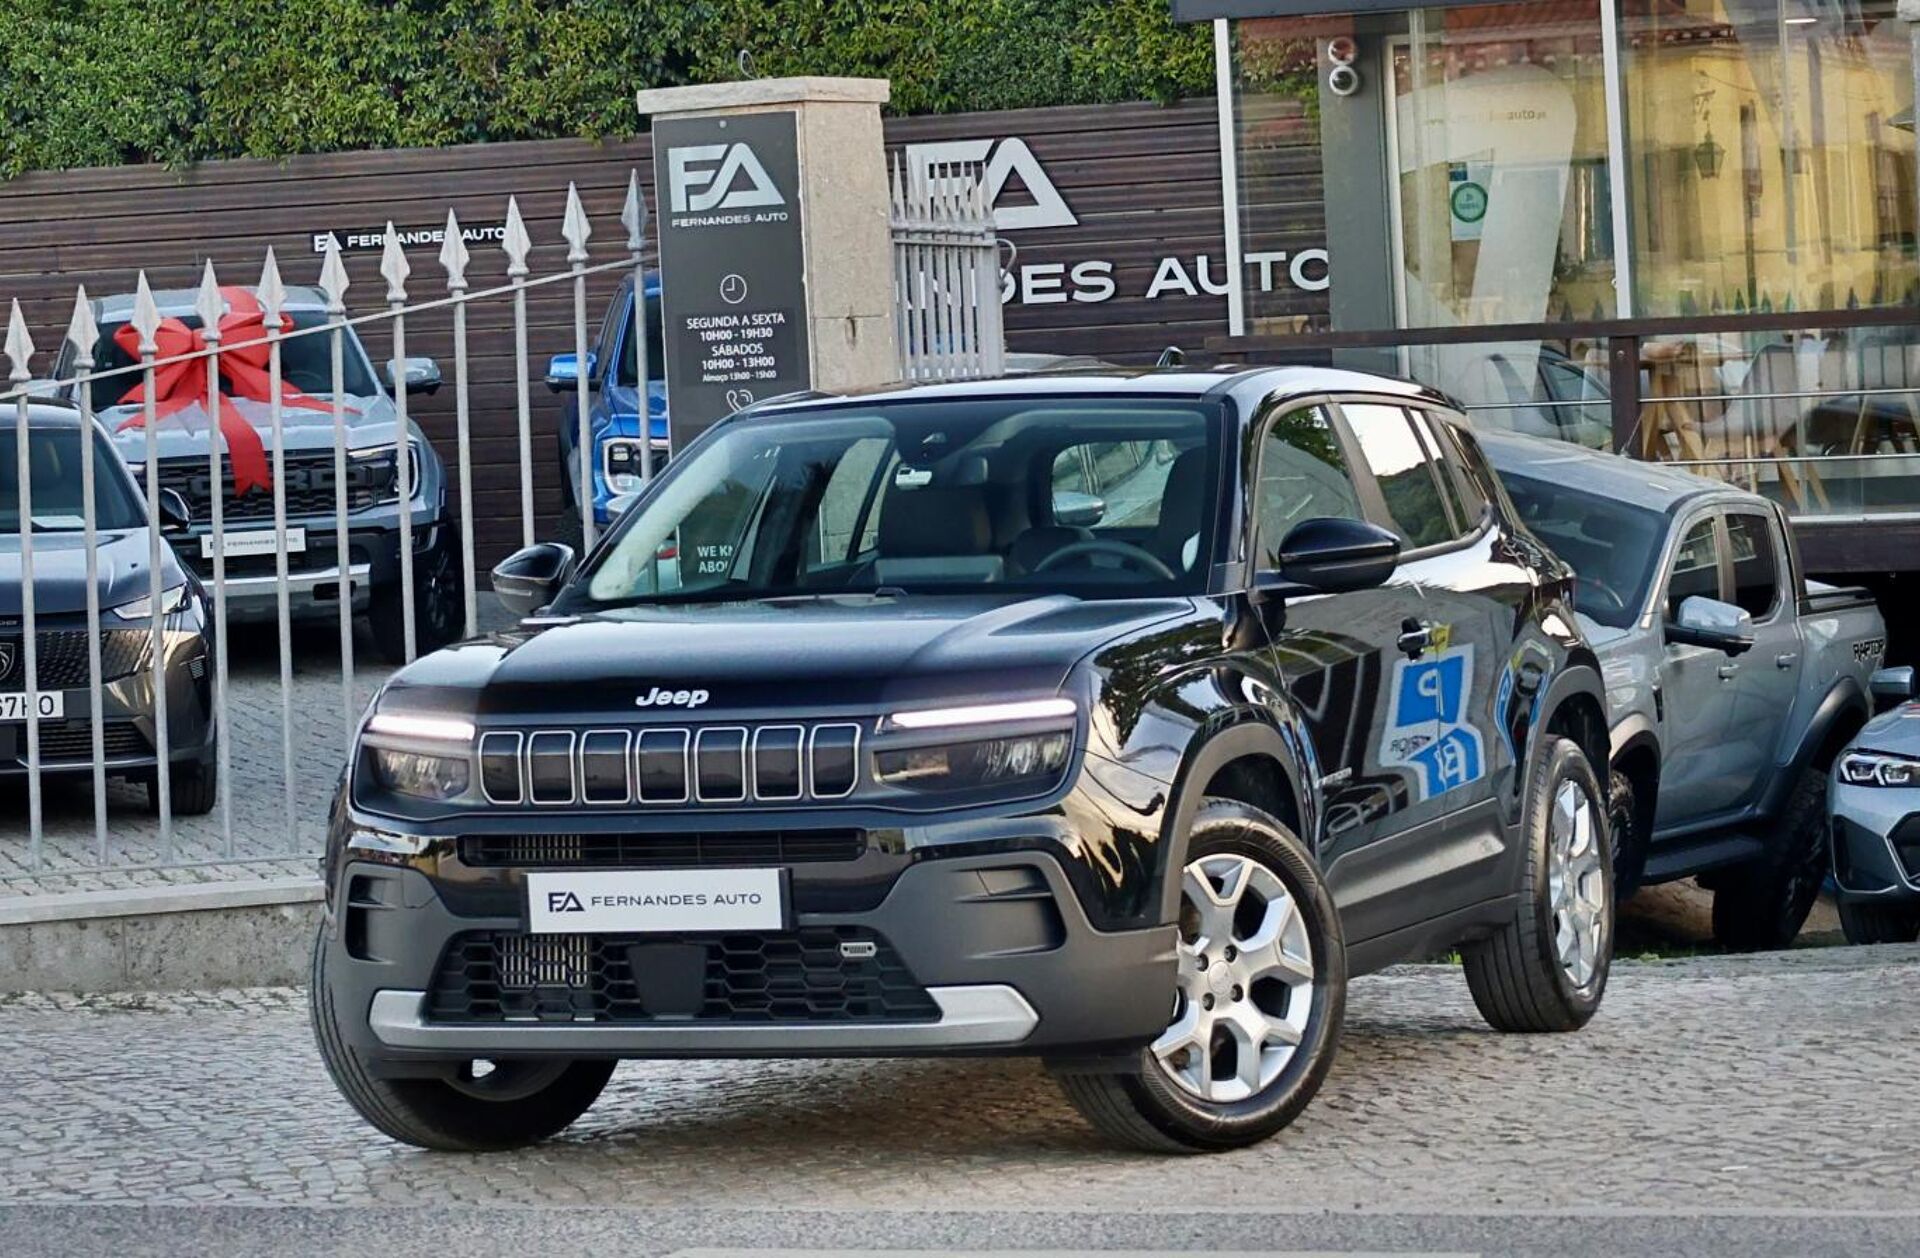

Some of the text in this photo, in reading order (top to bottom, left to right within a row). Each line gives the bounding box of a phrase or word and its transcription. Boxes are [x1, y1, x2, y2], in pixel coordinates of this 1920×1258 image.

[668, 142, 786, 212] FA
[671, 212, 788, 227] FERNANDES AUTO
[348, 231, 446, 248] FERANDE
[462, 227, 507, 241] AUTO
[1146, 249, 1329, 299] AUTO
[686, 313, 785, 330] SEGUNDA A SEXTA
[700, 330, 733, 341] 10H00
[741, 327, 773, 339] 19H30
[712, 342, 764, 357] SÁBADOS
[702, 359, 734, 370] 10H00
[743, 356, 775, 367] 13H00
[697, 545, 717, 557] WE
[1852, 638, 1885, 662] RAPTOR
[635, 687, 710, 709] Jeep
[548, 891, 762, 912] FA FERNANDES AUTO
